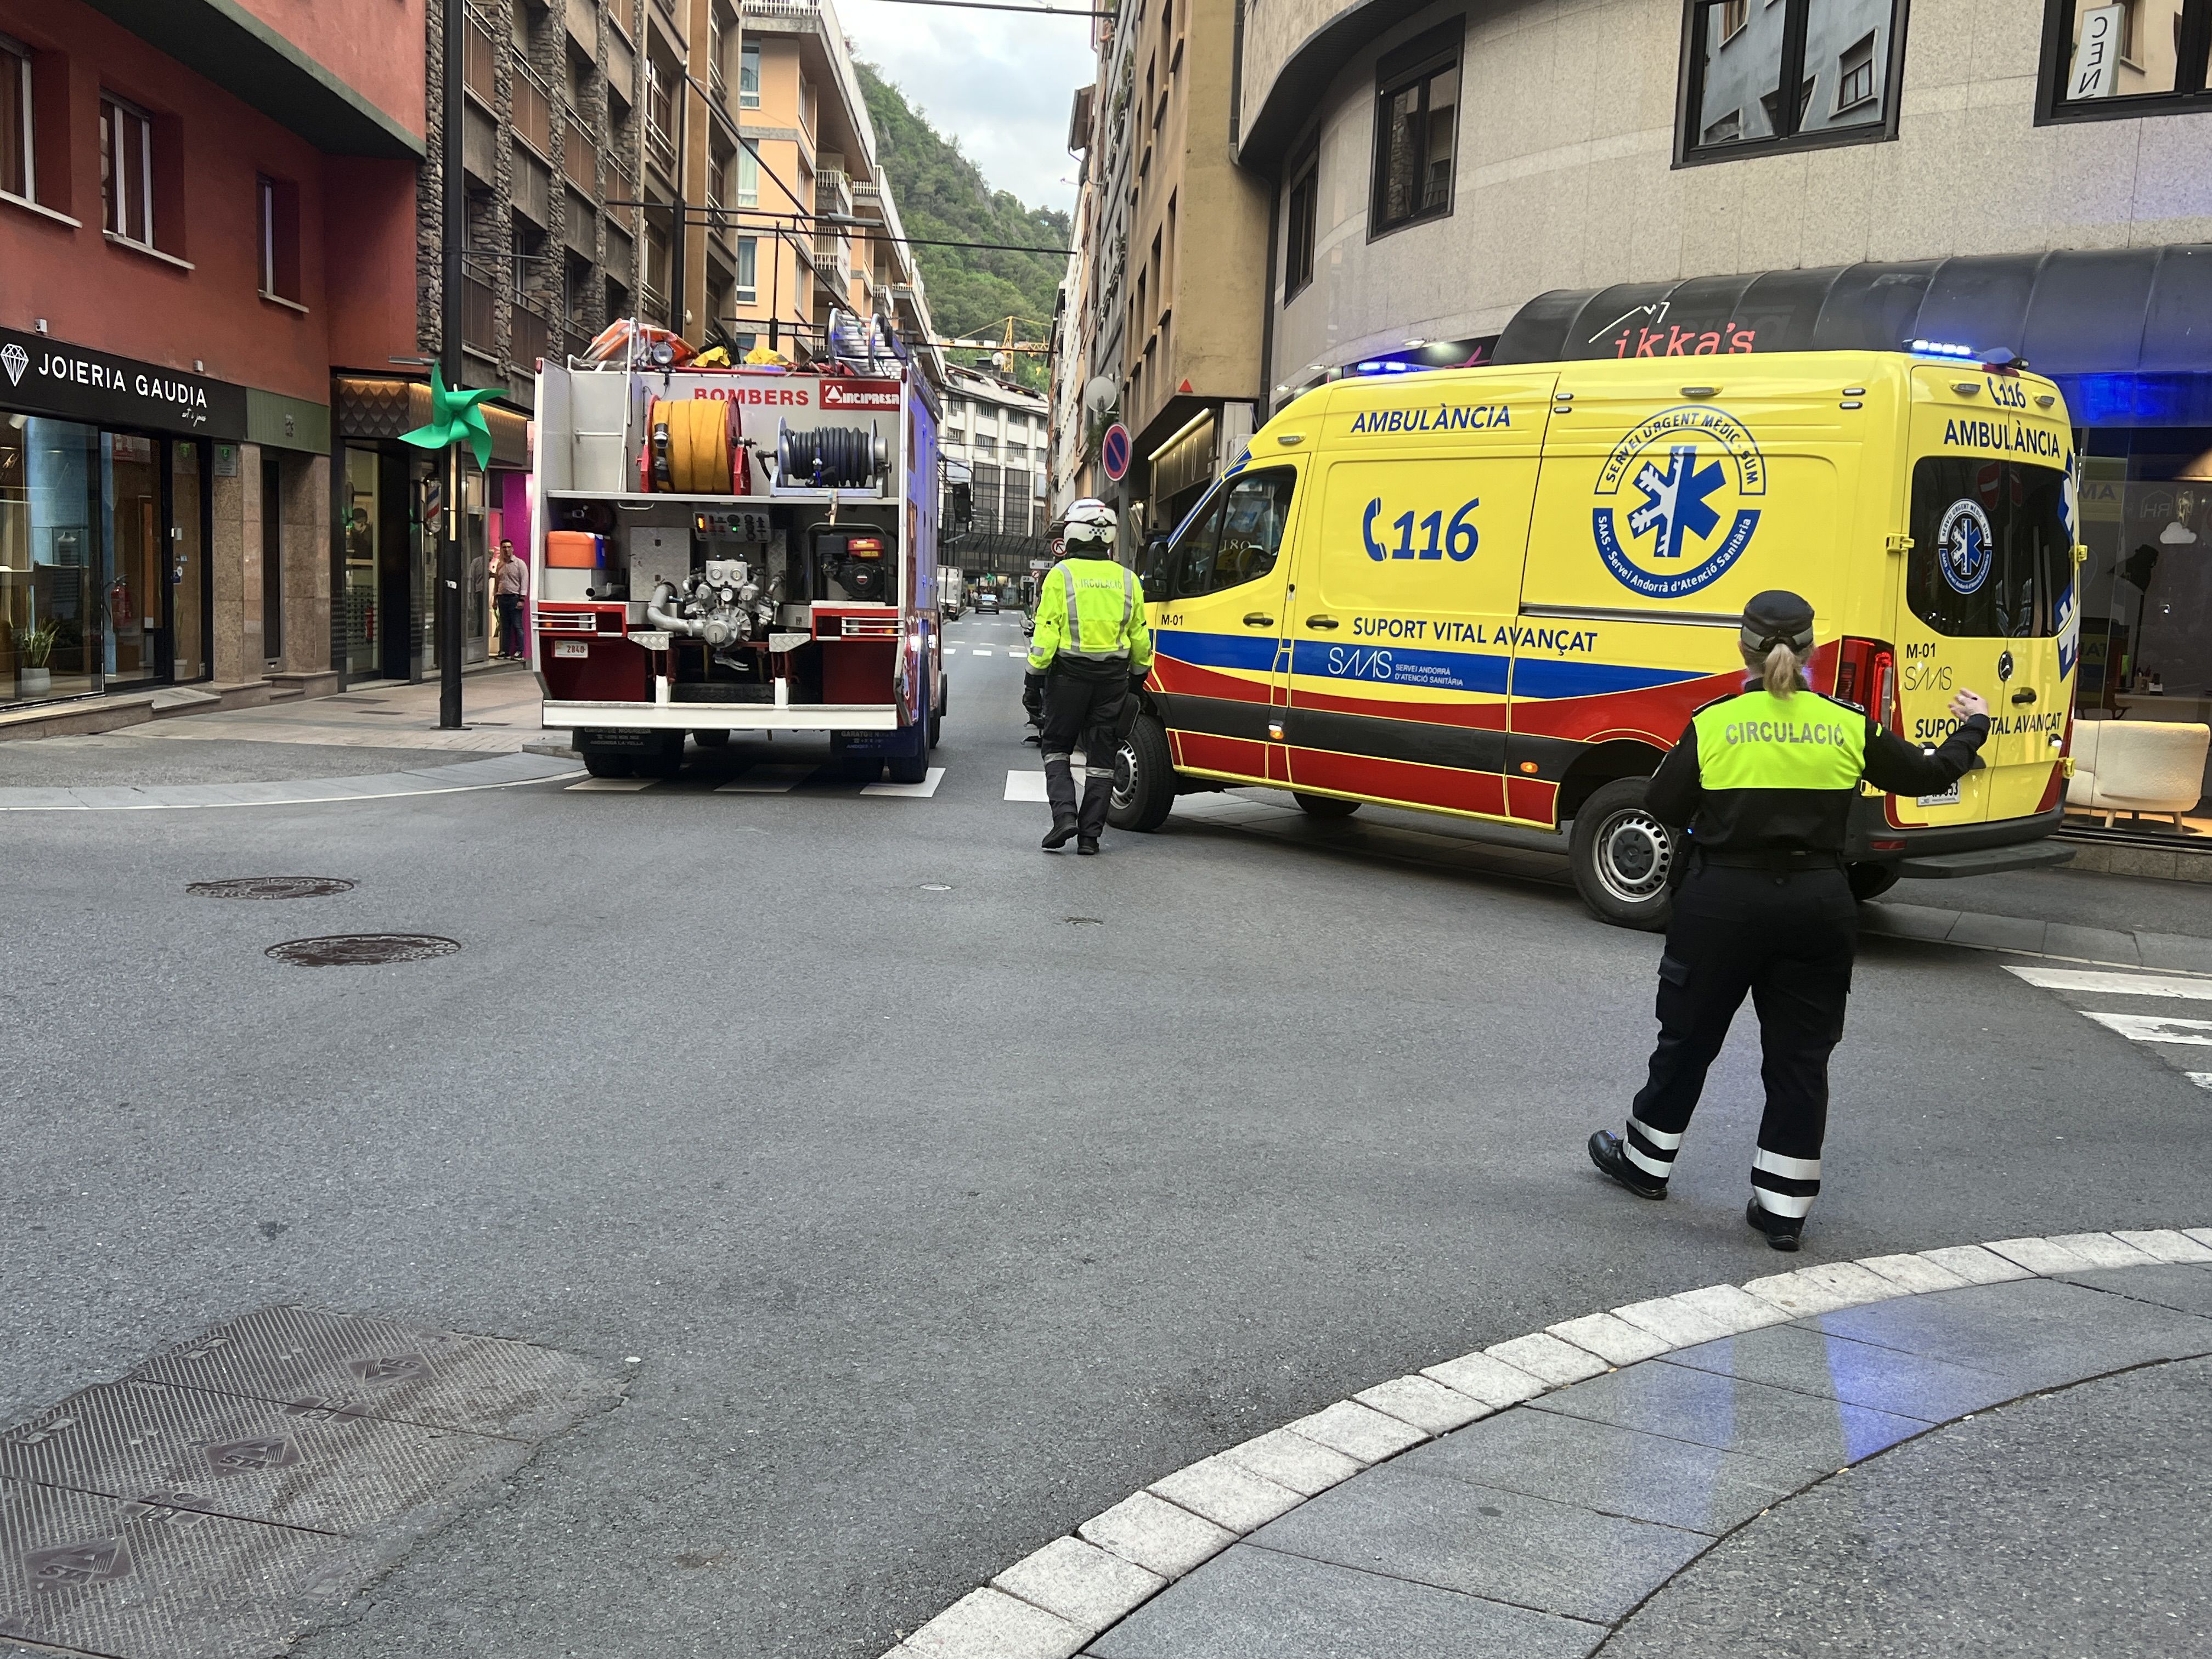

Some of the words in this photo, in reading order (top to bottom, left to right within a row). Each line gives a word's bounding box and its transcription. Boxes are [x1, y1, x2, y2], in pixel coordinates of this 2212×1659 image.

[38, 353, 126, 392] JOIERIA
[136, 375, 208, 408] GAUDIA
[694, 388, 809, 406] BOMBERS
[1999, 382, 2027, 409] 116
[1350, 403, 1510, 433] AMBULÀNCIA
[1606, 435, 1642, 483] SERVEI
[1643, 413, 1700, 438] URGENT
[1701, 415, 1741, 445] MÈDIC
[1740, 450, 1758, 485] SUM
[1944, 419, 2061, 459] AMBULÀNCIA
[1392, 497, 1480, 562] 116
[1598, 515, 1612, 546] SAAS
[1607, 550, 1632, 580] Servei
[1630, 574, 1669, 592] Andorrà
[1670, 562, 1718, 592] d'Atenció
[1716, 518, 1752, 568] Sanitària
[1075, 578, 1122, 590] CIRCULACIÓ
[1161, 614, 1183, 625] M-01
[1353, 617, 1427, 639] SUPORT
[1433, 622, 1487, 644] VITAL
[1493, 626, 1598, 656] AVANÇAT
[1906, 642, 1936, 659] M-01
[1395, 664, 1418, 673] SERVEI
[1725, 721, 1845, 747] CIRCULACIÓ
[1915, 718, 1966, 738] SUPO
[2013, 712, 2063, 736] AVANÇAT
